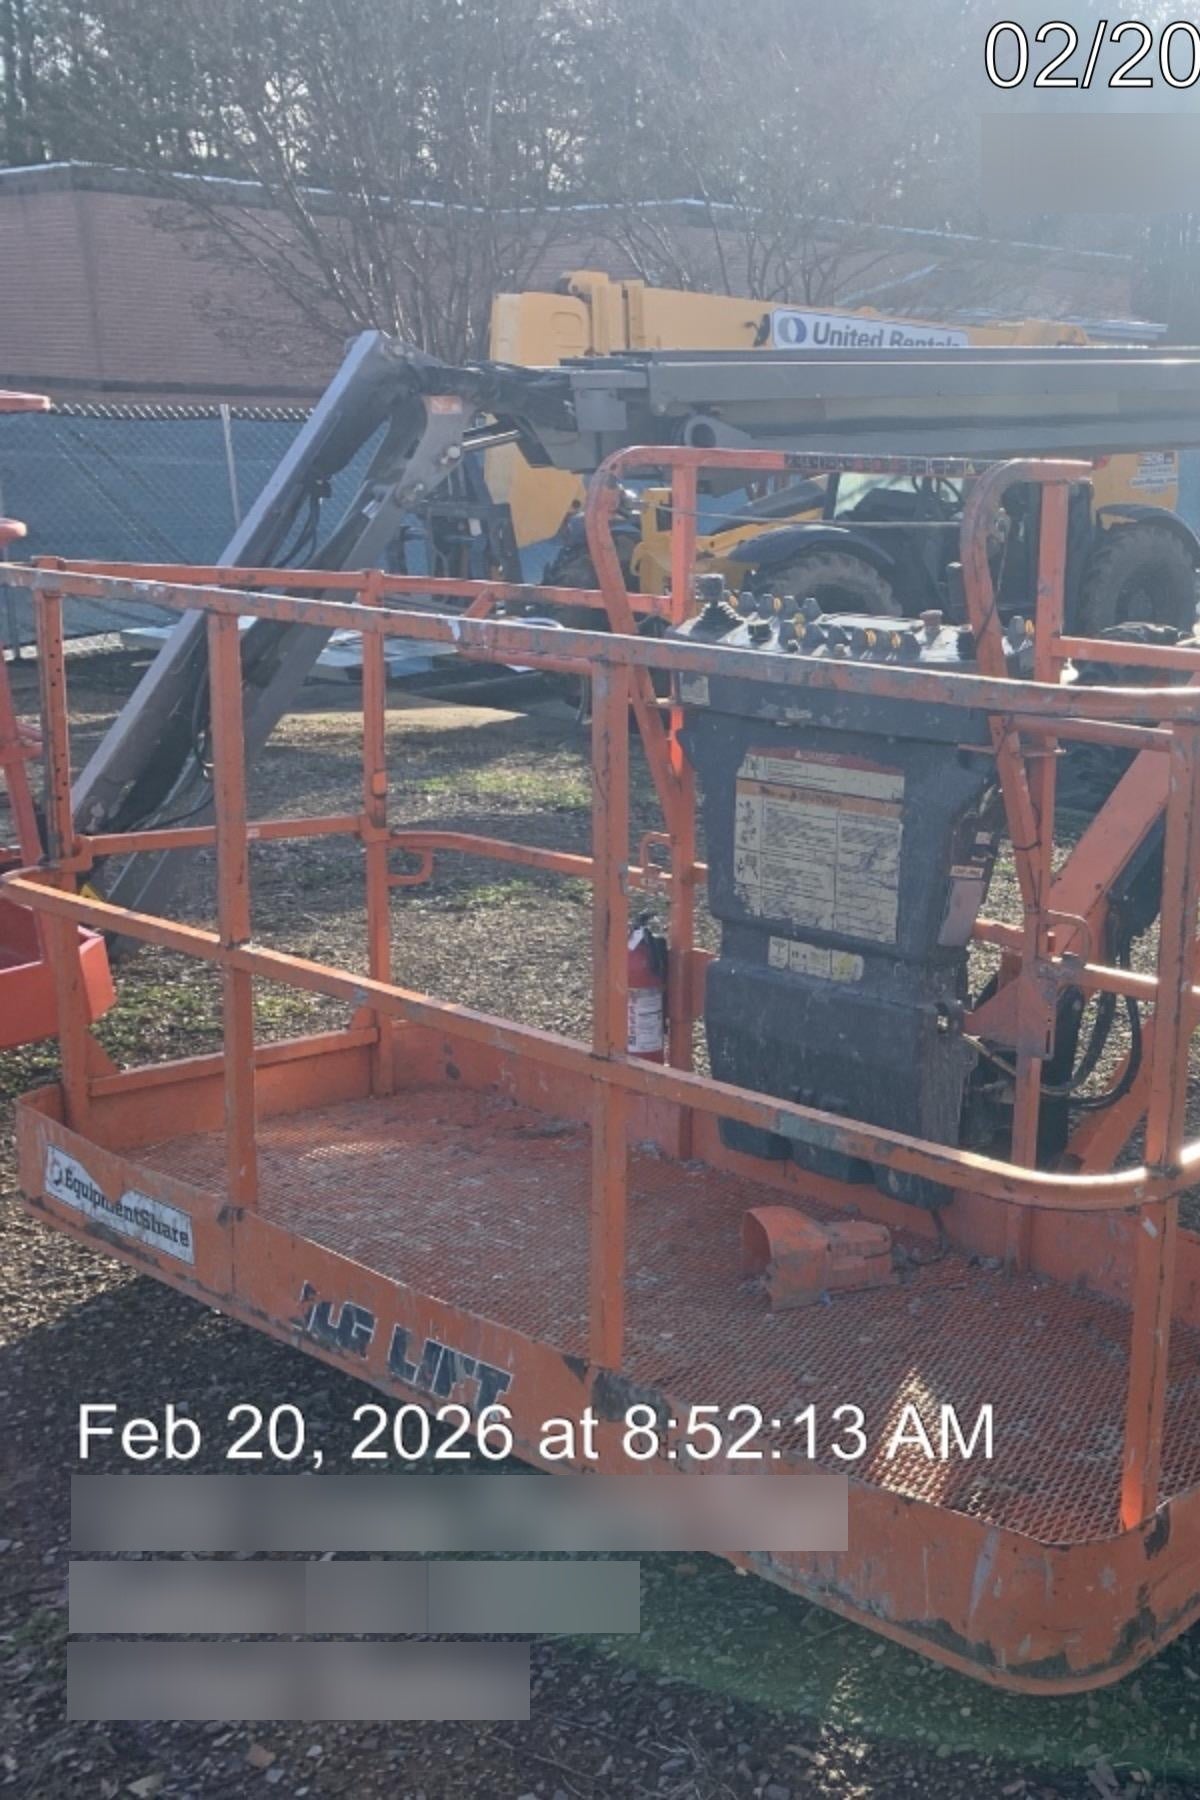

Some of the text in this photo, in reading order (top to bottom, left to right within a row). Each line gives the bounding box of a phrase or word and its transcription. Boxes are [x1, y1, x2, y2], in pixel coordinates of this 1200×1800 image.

[812, 321, 961, 348] United Rentl
[65, 1165, 190, 1249] EquipmentShare
